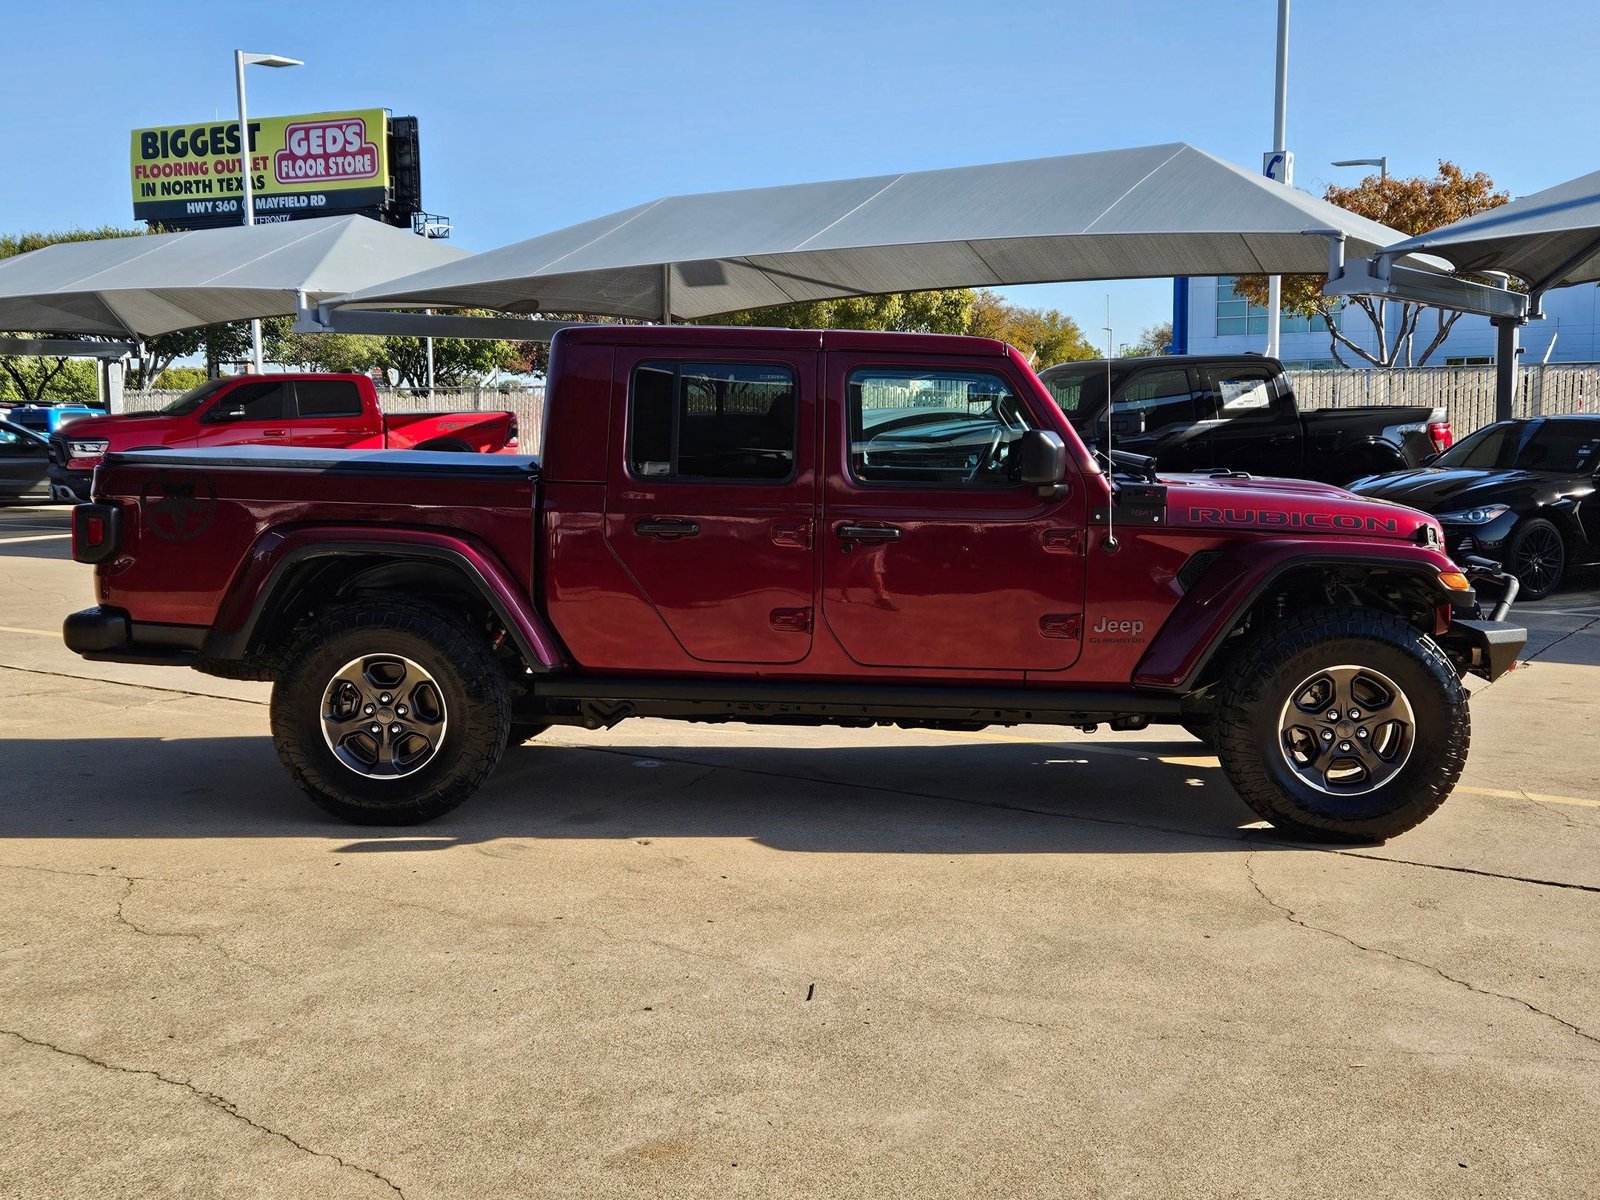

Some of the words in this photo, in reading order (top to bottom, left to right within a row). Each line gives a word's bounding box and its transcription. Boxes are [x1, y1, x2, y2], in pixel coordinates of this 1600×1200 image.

[141, 123, 260, 159] BIGGEST
[290, 125, 360, 156] GED'S
[135, 161, 209, 179] FLOORING
[214, 156, 269, 174] OUTET
[281, 158, 325, 177] FLOOR
[329, 154, 371, 175] STORE
[141, 182, 156, 197] IN
[161, 179, 212, 196] NORTH
[187, 201, 213, 214] HWY
[215, 200, 238, 212] 360
[255, 196, 308, 210] MAYFIELD
[310, 194, 327, 207] RD
[1189, 507, 1398, 532] RUBICON
[1093, 616, 1144, 636] Jeep
